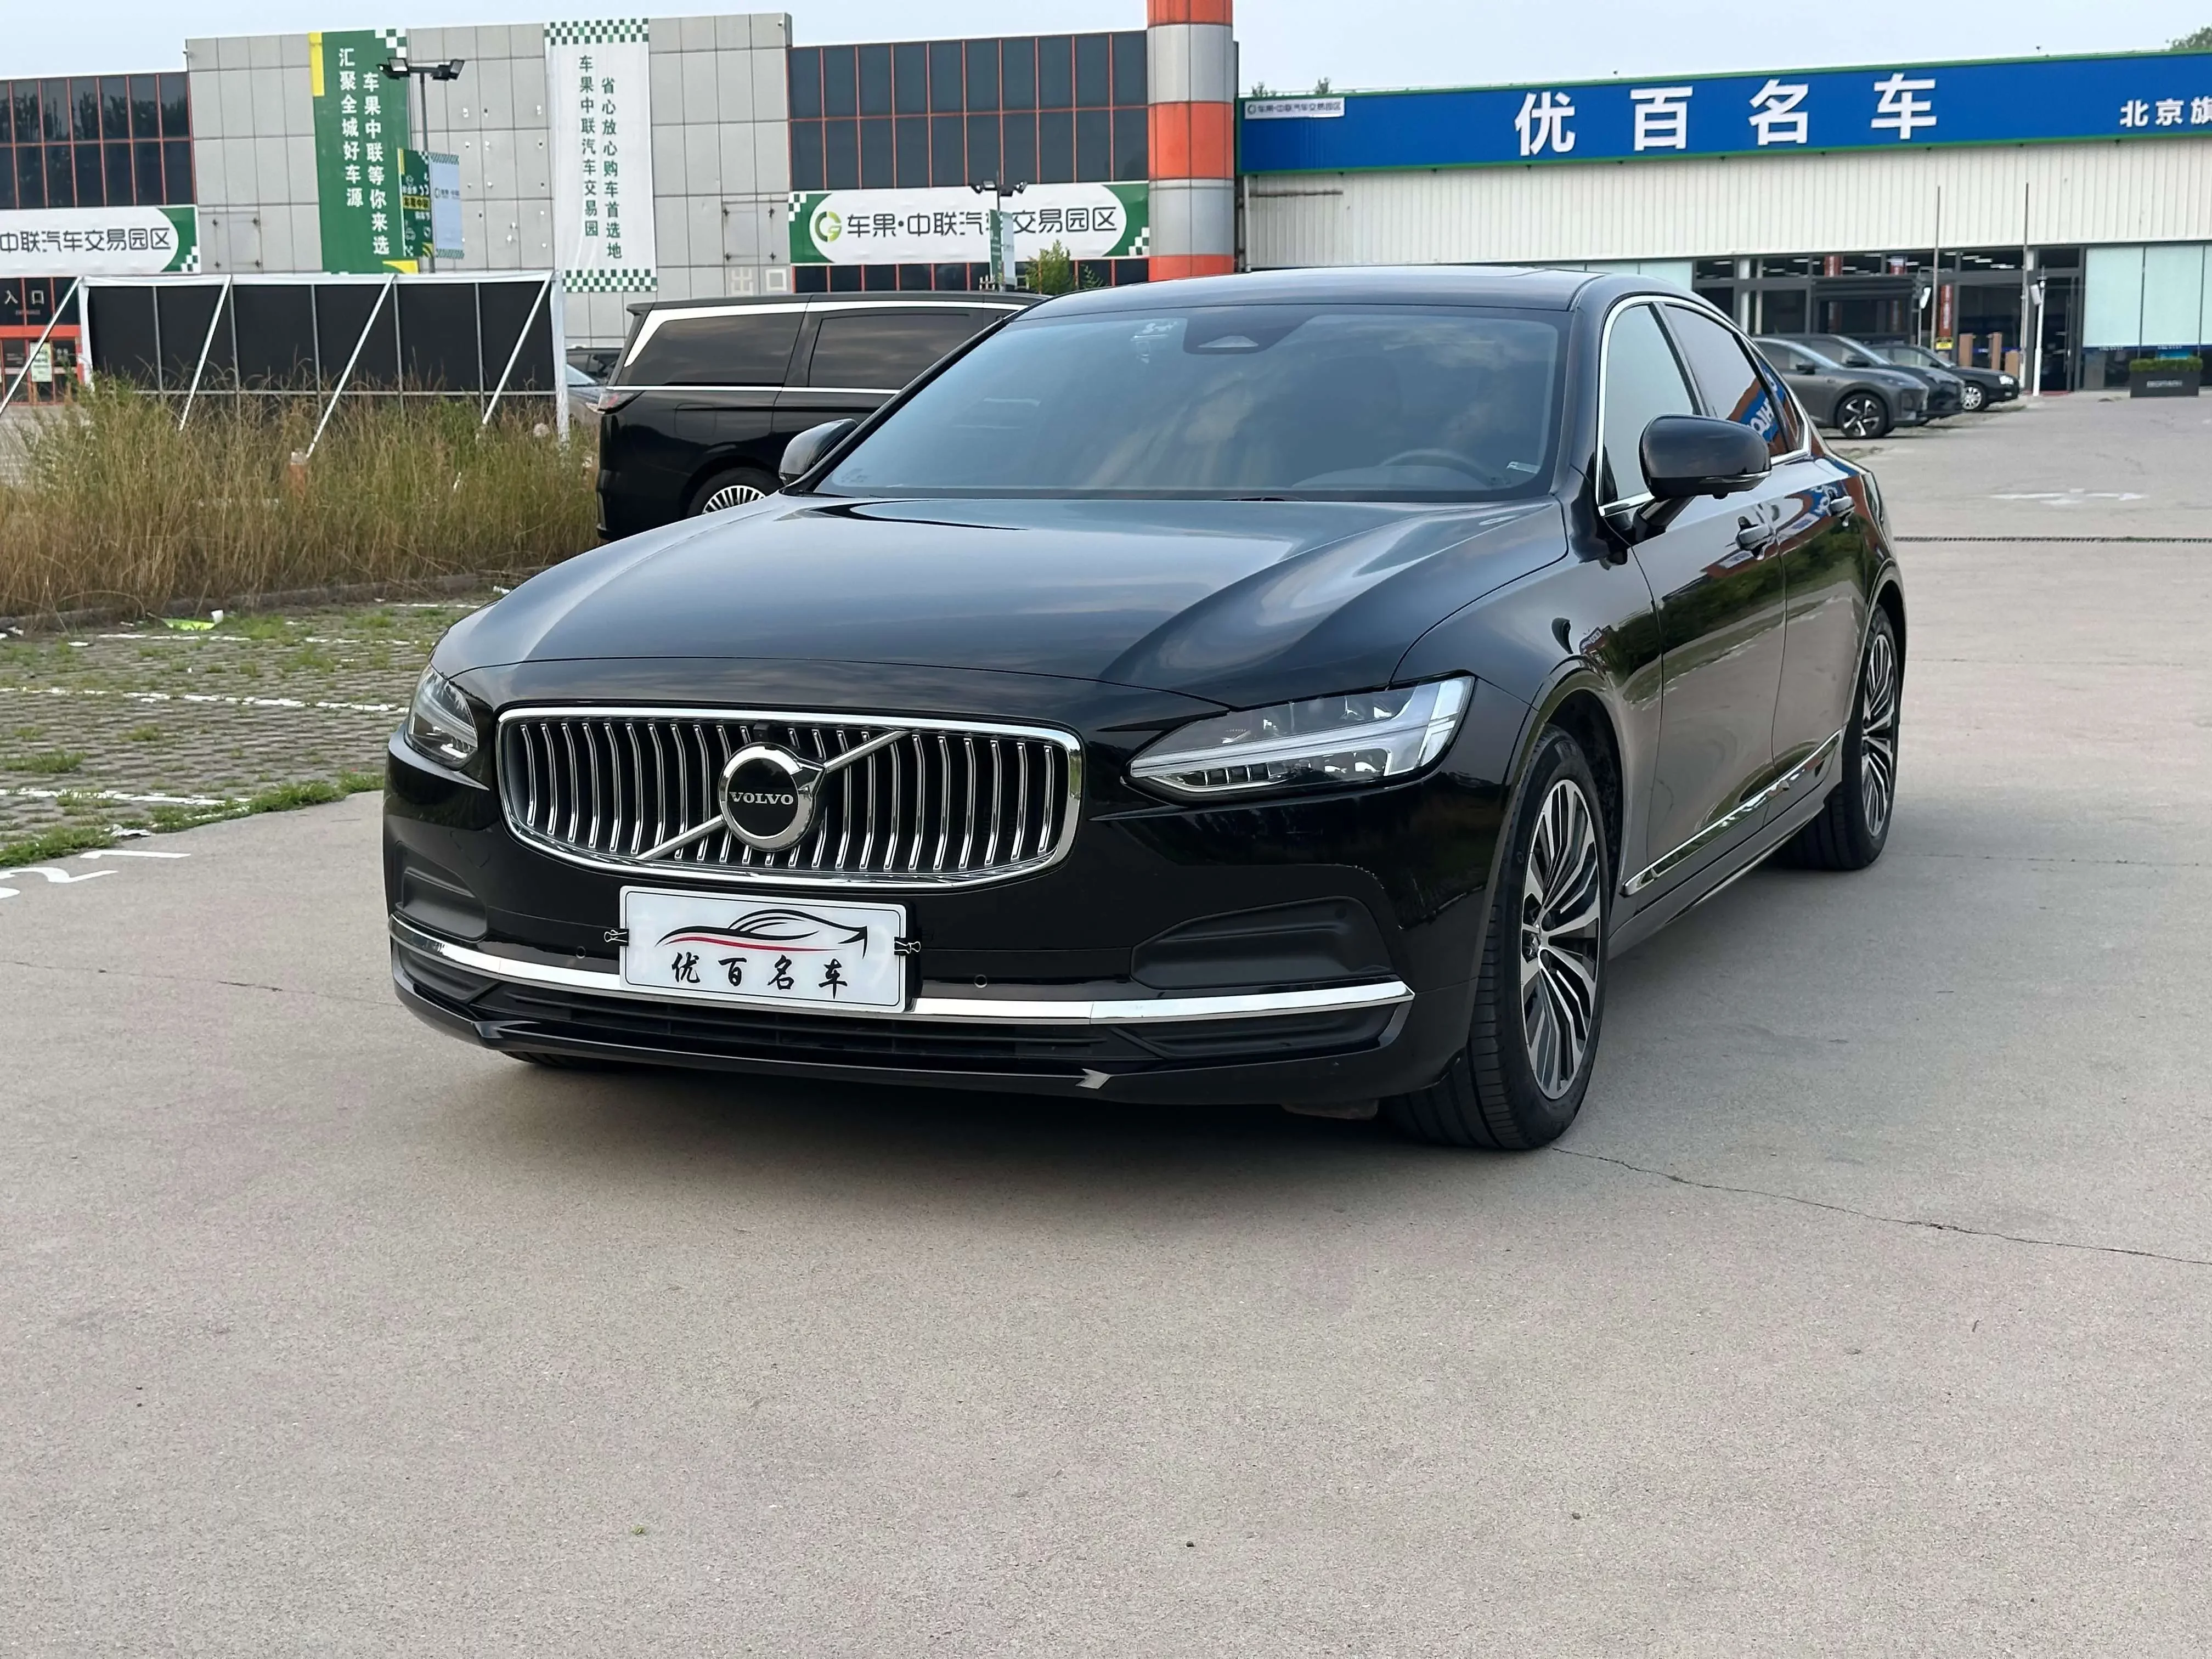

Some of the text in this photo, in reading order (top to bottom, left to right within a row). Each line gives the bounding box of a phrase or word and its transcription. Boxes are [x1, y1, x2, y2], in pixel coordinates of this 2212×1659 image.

[338, 48, 364, 208] 汇聚全城好车源
[1514, 72, 1938, 156] 优百名车
[2119, 95, 2212, 128] 北京旗
[363, 71, 390, 256] 车果中联等你来选
[579, 54, 599, 237] 车果中联汽车交易园
[601, 77, 622, 259] 省心放心购车首选地
[0, 227, 171, 253] 中联汽车交易园区
[847, 206, 1118, 238] 车果·中联汽交易园区
[4, 289, 44, 305] 入口
[729, 791, 794, 806] VOLVO
[671, 952, 848, 1000] 优百名车
